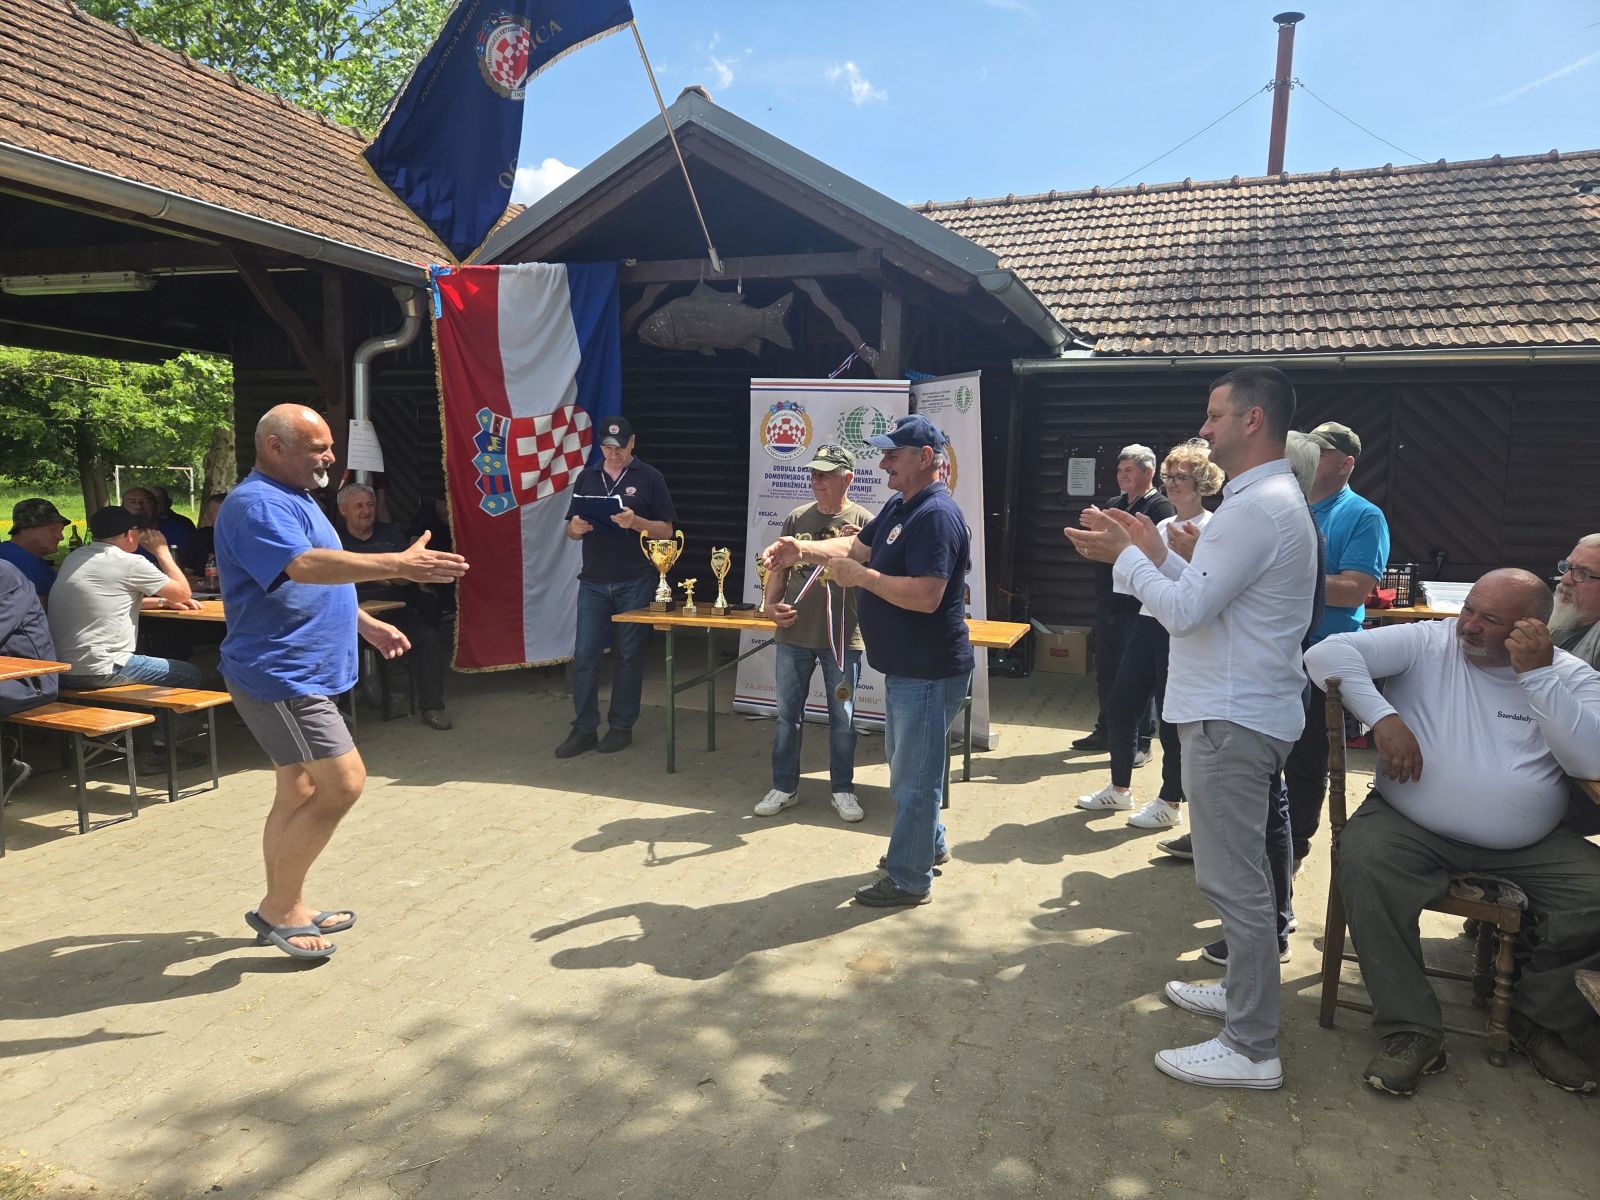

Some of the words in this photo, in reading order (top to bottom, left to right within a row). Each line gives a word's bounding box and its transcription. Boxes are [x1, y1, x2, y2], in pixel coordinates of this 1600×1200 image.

[773, 465, 796, 473] UDRUGA
[764, 473, 805, 481] DOMOVINSKOG
[853, 477, 882, 485] HRVATSKE
[771, 480, 807, 489] PODRUŽNICA
[848, 485, 873, 494] UPANIJE
